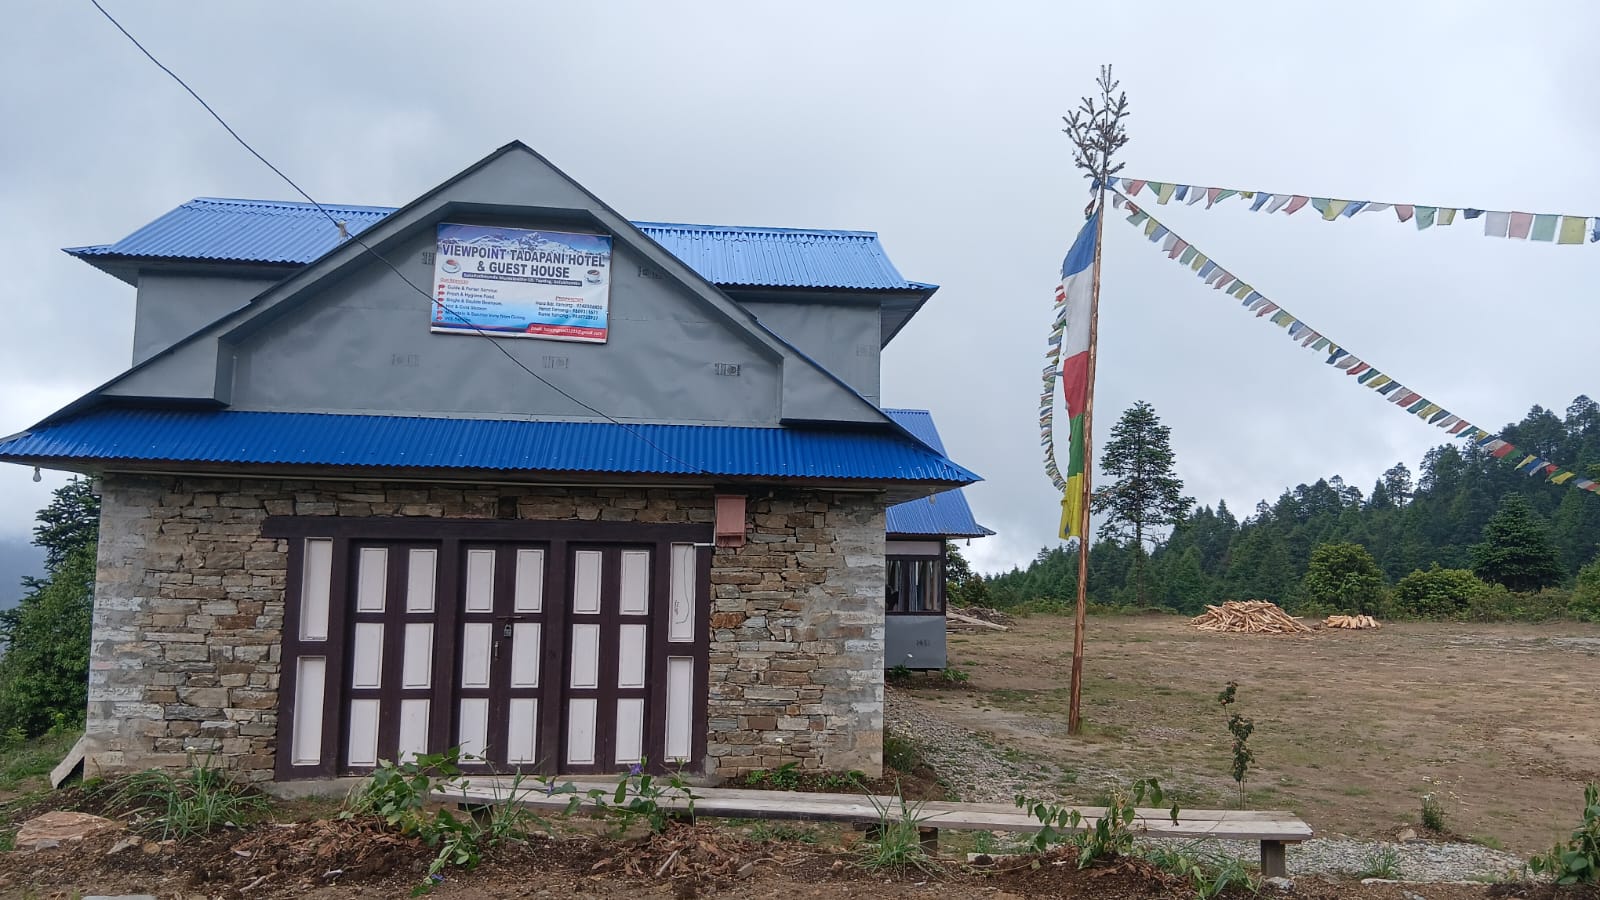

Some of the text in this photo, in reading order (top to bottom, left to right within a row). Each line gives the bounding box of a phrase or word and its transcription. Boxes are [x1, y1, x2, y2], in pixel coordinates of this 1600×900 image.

[442, 244, 506, 260] VIEWPOINT
[510, 249, 564, 265] TADAPANI
[568, 255, 605, 267] HOTEL
[477, 262, 570, 278] & GUEST HOUSE
